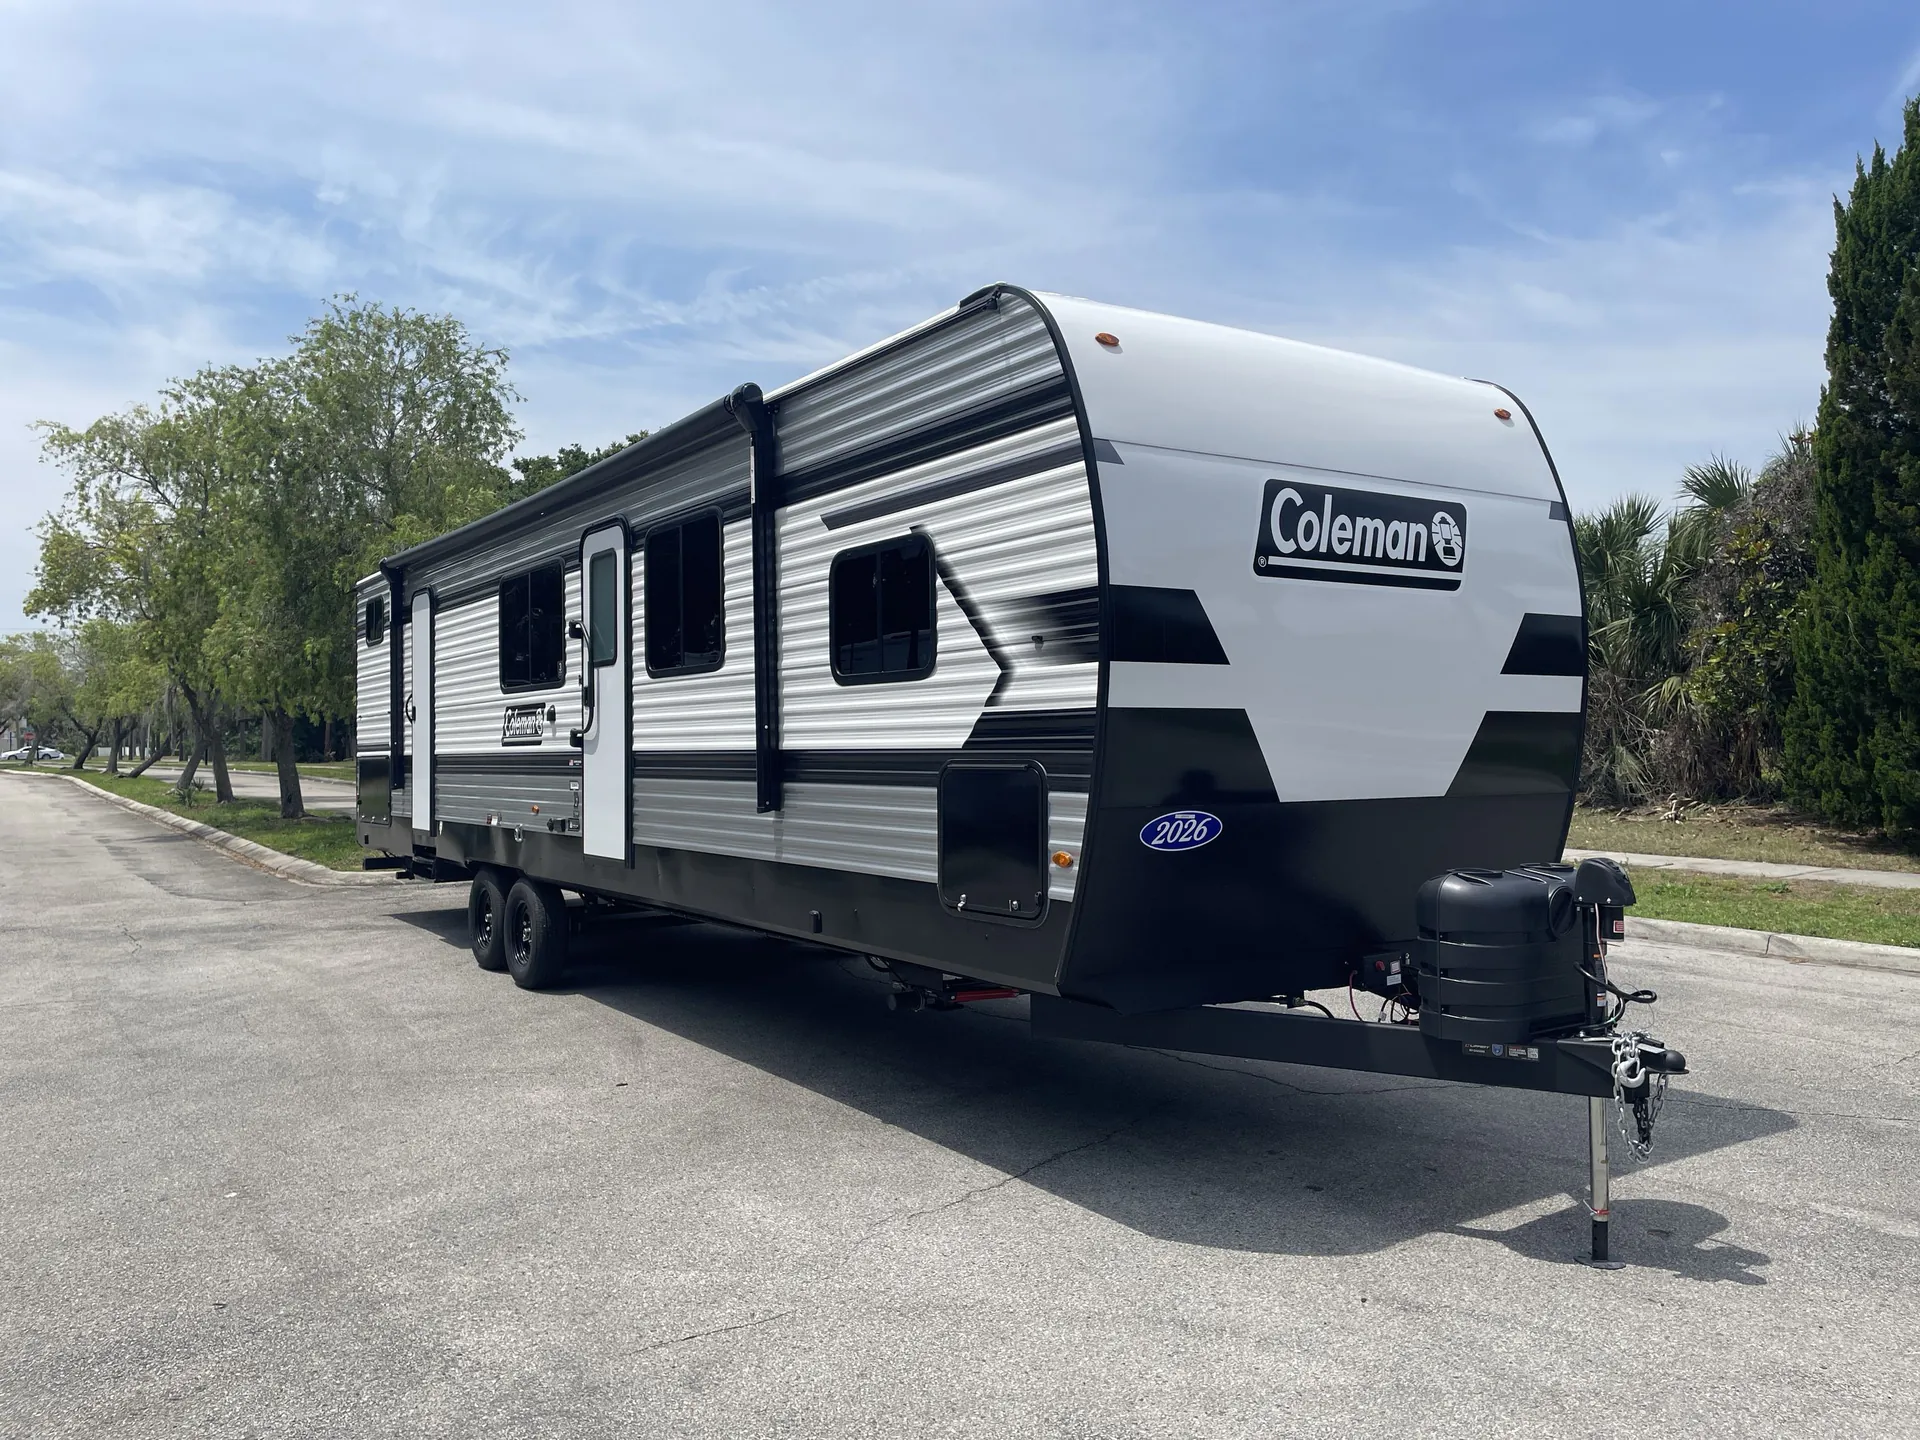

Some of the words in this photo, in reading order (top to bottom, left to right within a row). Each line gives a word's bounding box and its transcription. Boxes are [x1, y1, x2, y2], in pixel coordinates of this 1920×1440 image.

[1270, 487, 1428, 562] Coleman
[504, 708, 536, 737] Coleman
[1151, 817, 1212, 845] 2026
